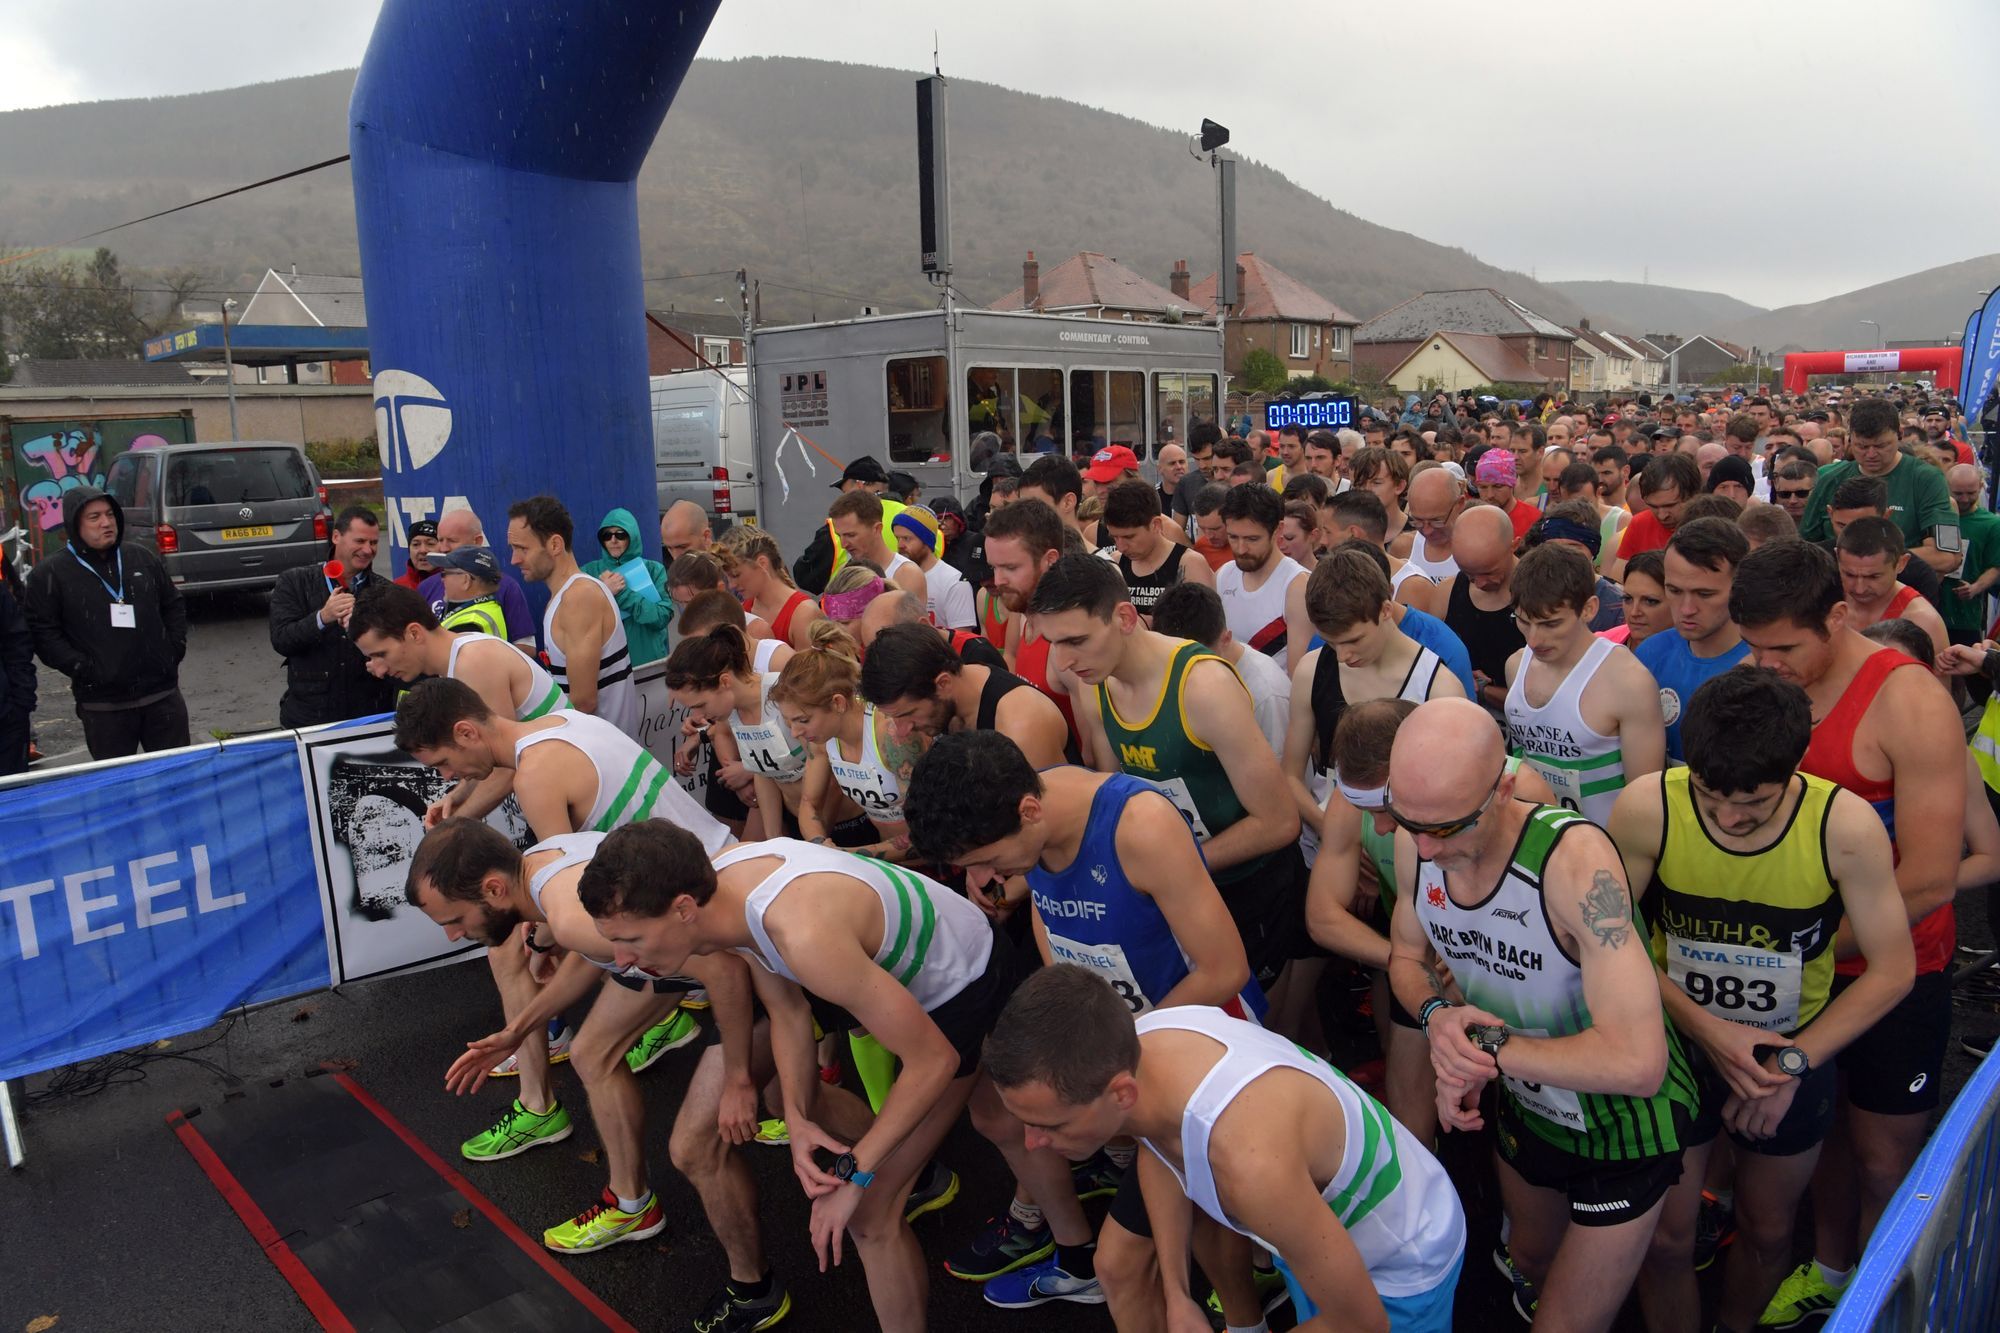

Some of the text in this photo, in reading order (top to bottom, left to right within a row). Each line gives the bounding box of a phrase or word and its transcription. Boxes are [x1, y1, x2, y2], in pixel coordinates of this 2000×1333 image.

[1060, 331, 1150, 345] COMMENTARY CONTROL
[783, 373, 824, 391] JPL
[1269, 401, 1350, 427] 00:00:00
[384, 495, 490, 548] ATA
[225, 527, 269, 538] RA66 BZU
[1136, 587, 1165, 596] TALBOT
[1131, 597, 1157, 606] RRIERS
[752, 730, 774, 740] STEEL
[1510, 723, 1575, 744] SWANSEA
[1513, 736, 1581, 757] RRIERS
[749, 749, 779, 773] 14
[847, 768, 871, 780] STEEL
[1542, 771, 1570, 787] STEEL
[0, 844, 247, 961] TEEL
[1032, 889, 1106, 921] CARDIFF
[1429, 921, 1543, 971] PARC BRYN BACH
[1077, 952, 1116, 968] STEEL
[1444, 946, 1526, 981] Running Club
[1679, 945, 1787, 968] TATA STEEL
[1685, 971, 1777, 1012] 983
[1773, 1016, 1791, 1025] 10K
[1560, 1111, 1581, 1122] 10K
